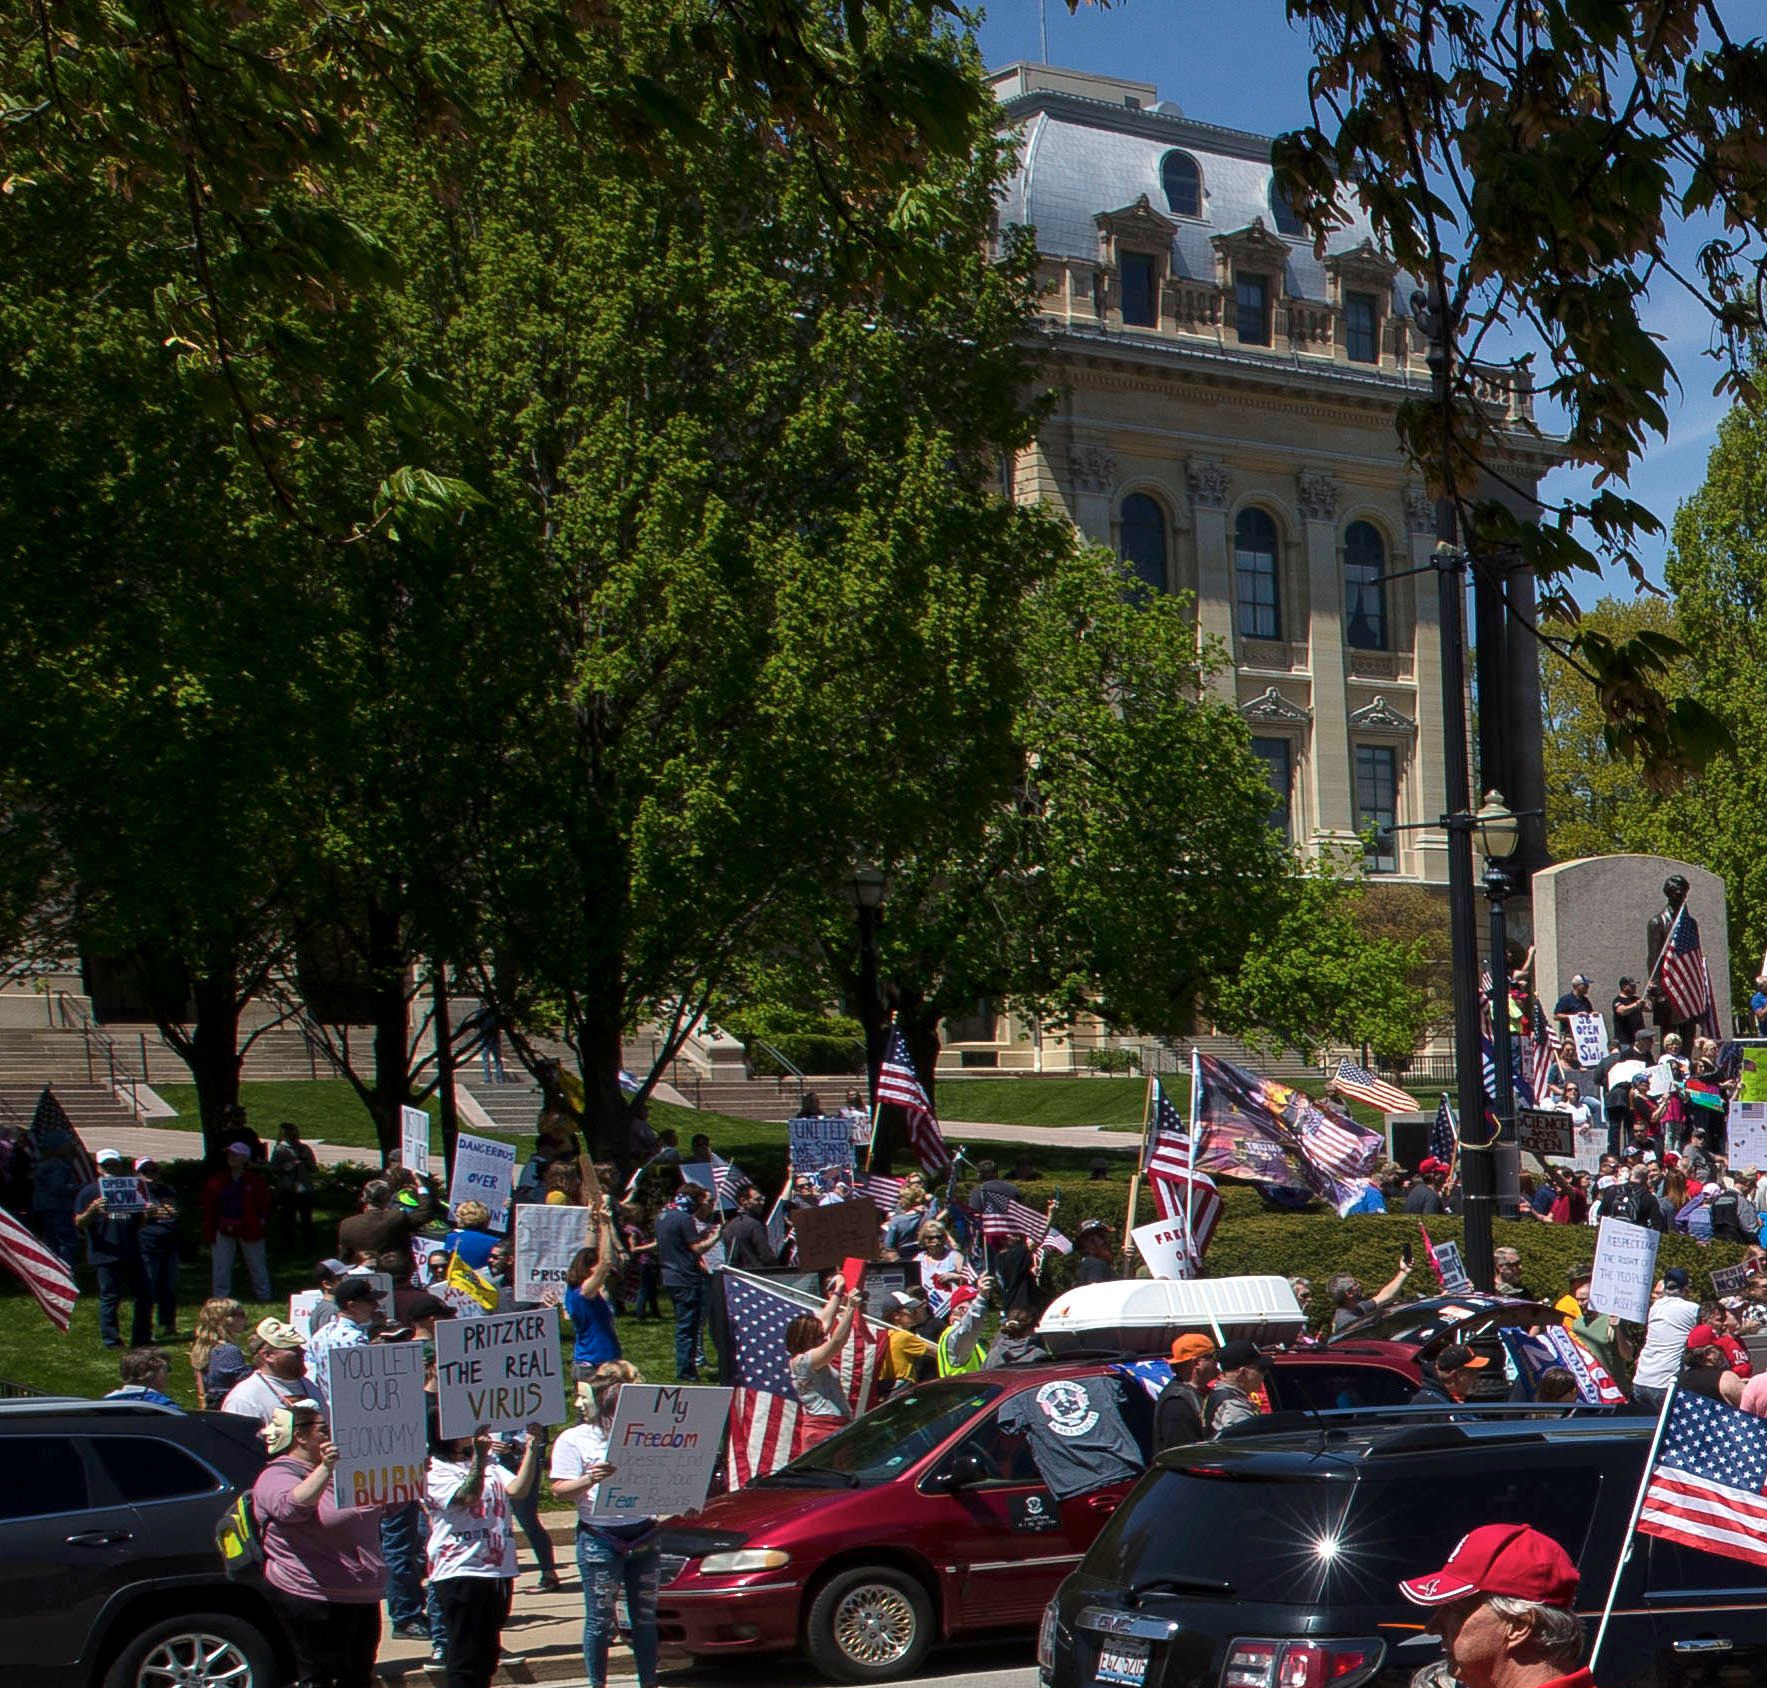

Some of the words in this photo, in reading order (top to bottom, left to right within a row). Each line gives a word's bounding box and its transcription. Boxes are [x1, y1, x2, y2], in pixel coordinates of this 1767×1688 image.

[1576, 1026, 1600, 1037] OPEN
[794, 1121, 848, 1140] UNITED
[458, 1138, 514, 1162] DANGEROUS
[468, 1171, 499, 1189] OVER
[1607, 1234, 1657, 1253] RESPECTING
[1602, 1252, 1616, 1264] THE
[1617, 1254, 1639, 1266] RIGHT
[1600, 1267, 1615, 1280] THE
[1616, 1270, 1649, 1286] PEOPLE
[1716, 1276, 1746, 1291] NOW
[463, 1315, 547, 1354] PRITZKER
[336, 1348, 375, 1380] YOU
[383, 1344, 421, 1377] LET
[439, 1359, 484, 1386] THE
[505, 1348, 556, 1380] REAL
[360, 1380, 401, 1412] OUR
[467, 1382, 544, 1421] VIRUS
[653, 1386, 690, 1424] My
[336, 1422, 419, 1460] ECONOMY
[623, 1423, 699, 1449] Freedom
[353, 1462, 425, 1508] BURN
[605, 1487, 641, 1509] Fear
[1097, 1614, 1135, 1634] GMC
